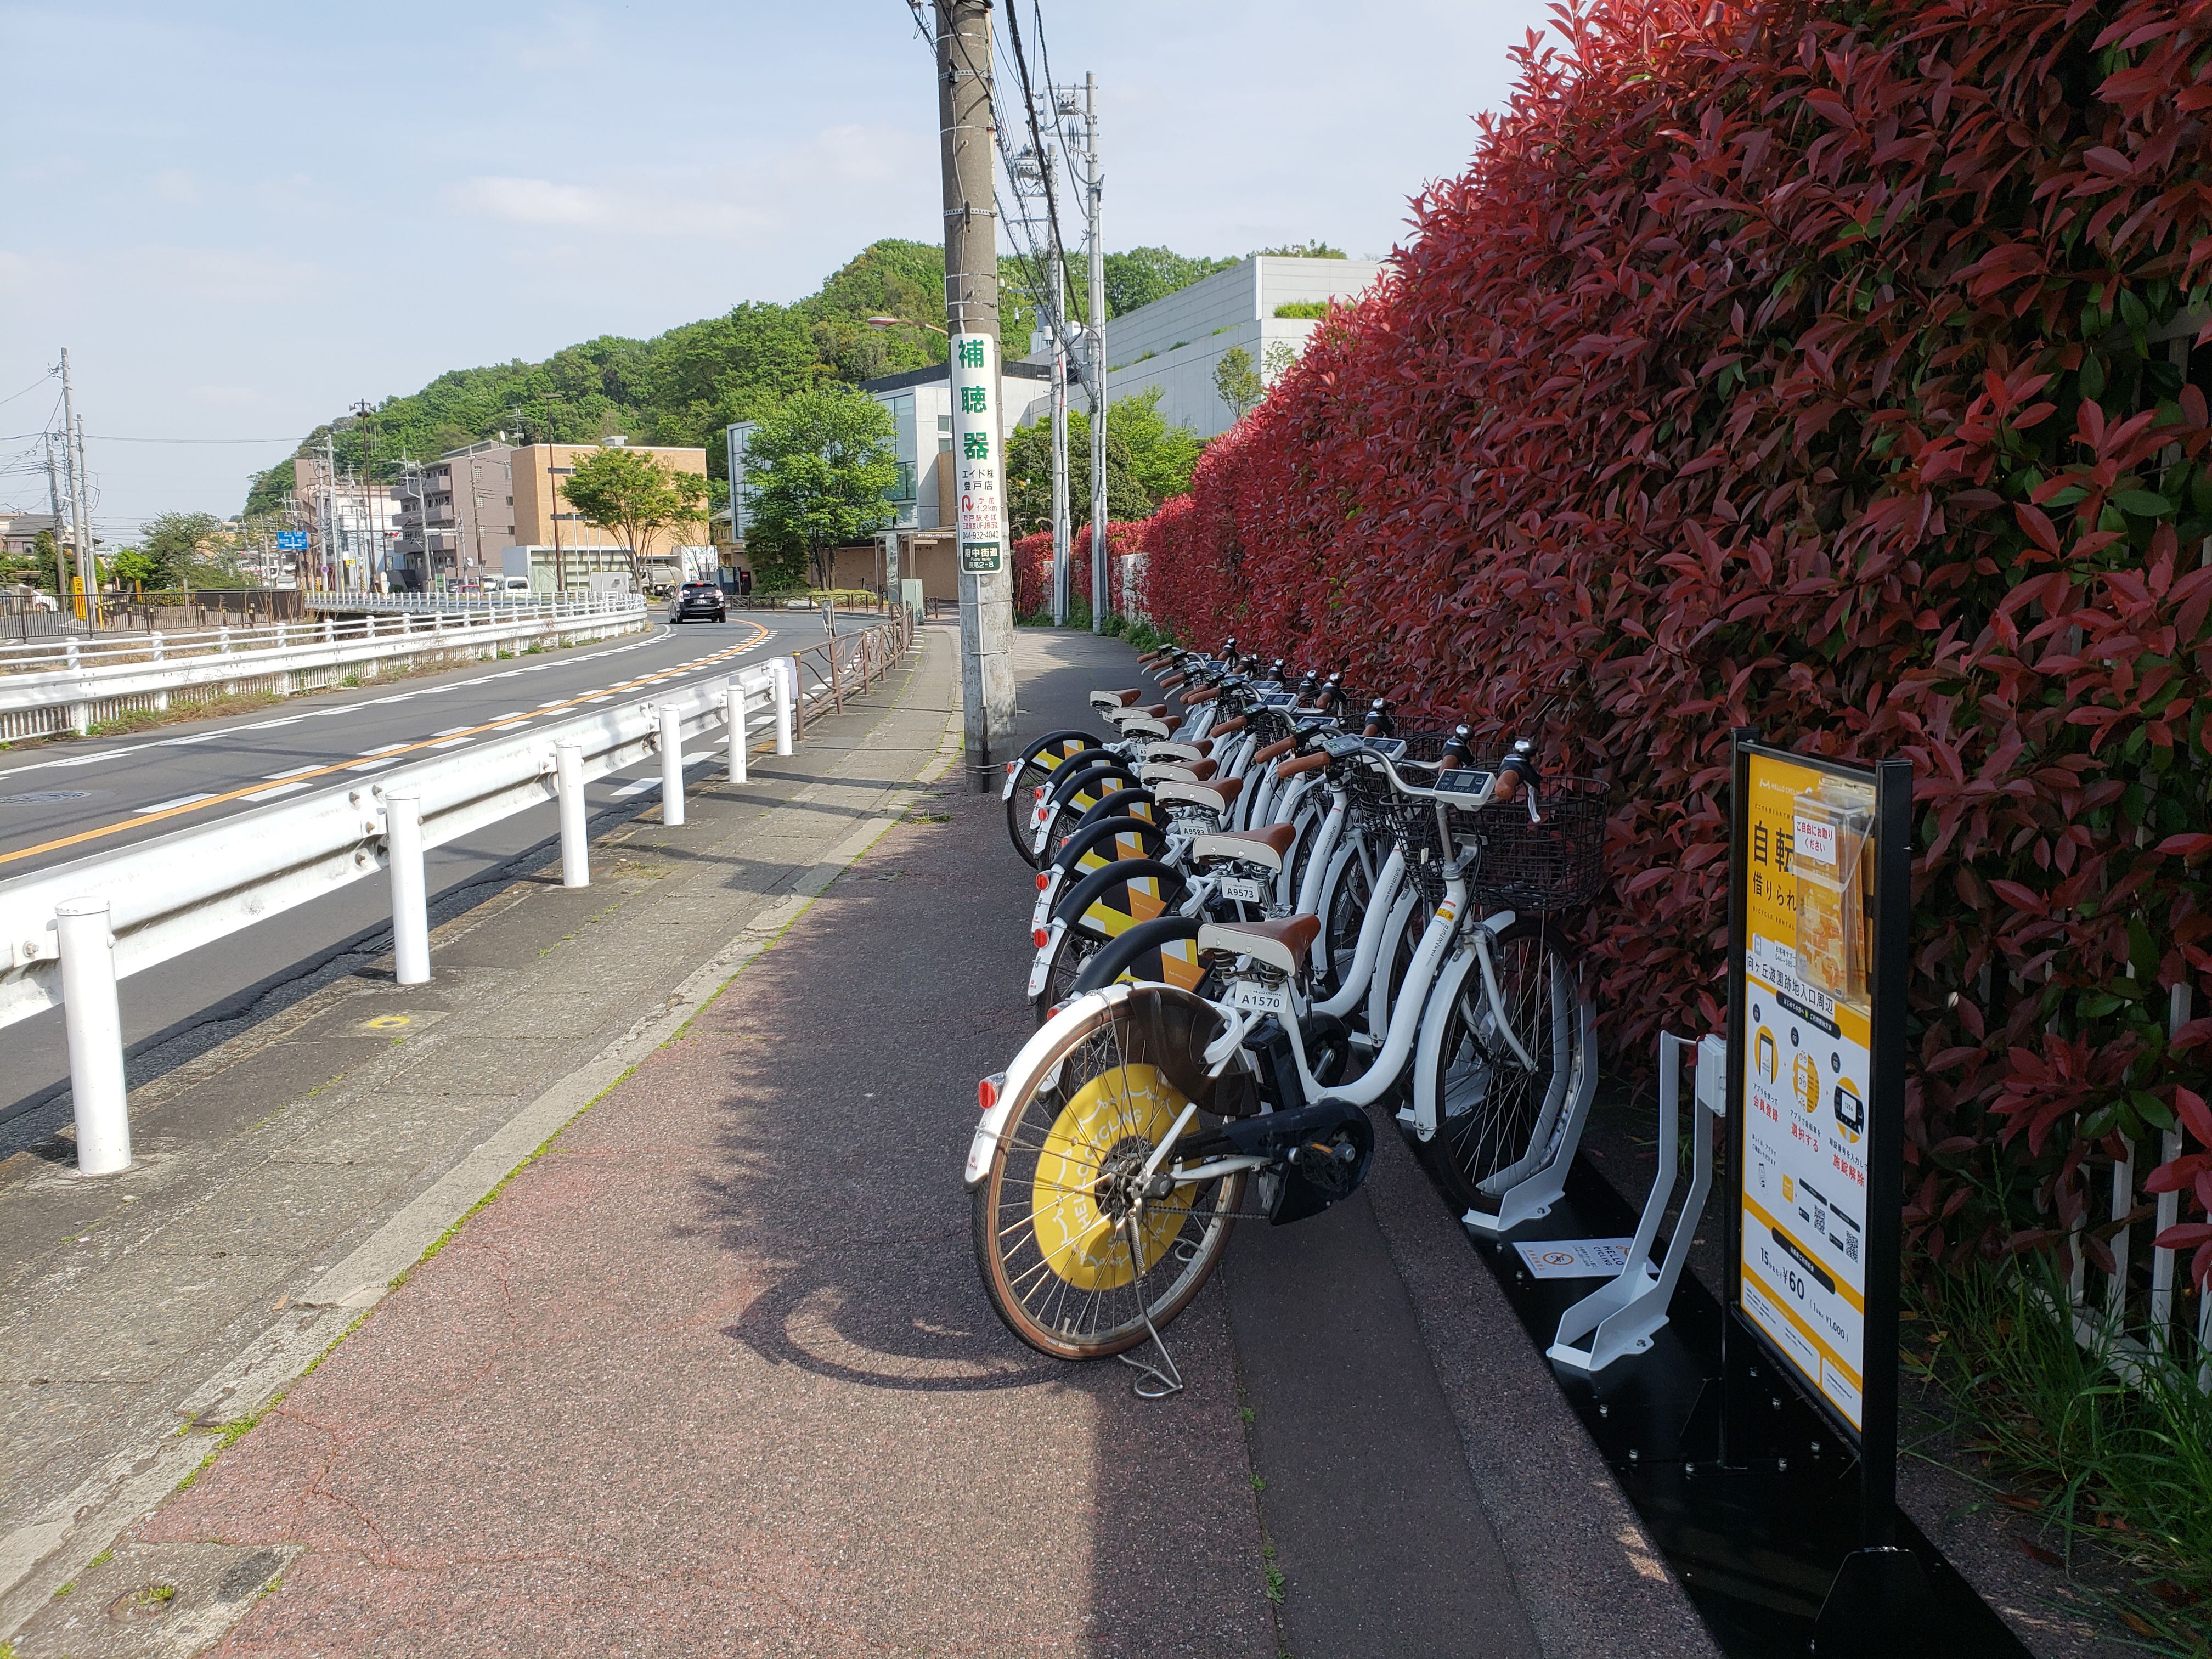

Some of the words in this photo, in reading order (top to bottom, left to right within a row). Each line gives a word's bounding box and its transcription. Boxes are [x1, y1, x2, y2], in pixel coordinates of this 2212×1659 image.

[958, 339, 989, 460] 補聴器
[964, 481, 992, 491] 登戸店
[963, 531, 999, 539] 044-932-4040
[964, 548, 998, 558] 府中街道
[1797, 819, 1832, 843] ご自由にお取り
[1804, 837, 1825, 854] ください
[1227, 888, 1254, 898] A9573
[1752, 869, 1796, 912] 借りられ
[1242, 995, 1279, 1008] A1570
[1753, 1092, 1778, 1124] 会員登録
[1791, 1120, 1818, 1154] 選択する
[1593, 1246, 1612, 1266] CYCLING
[1603, 1246, 1624, 1265] HELLO
